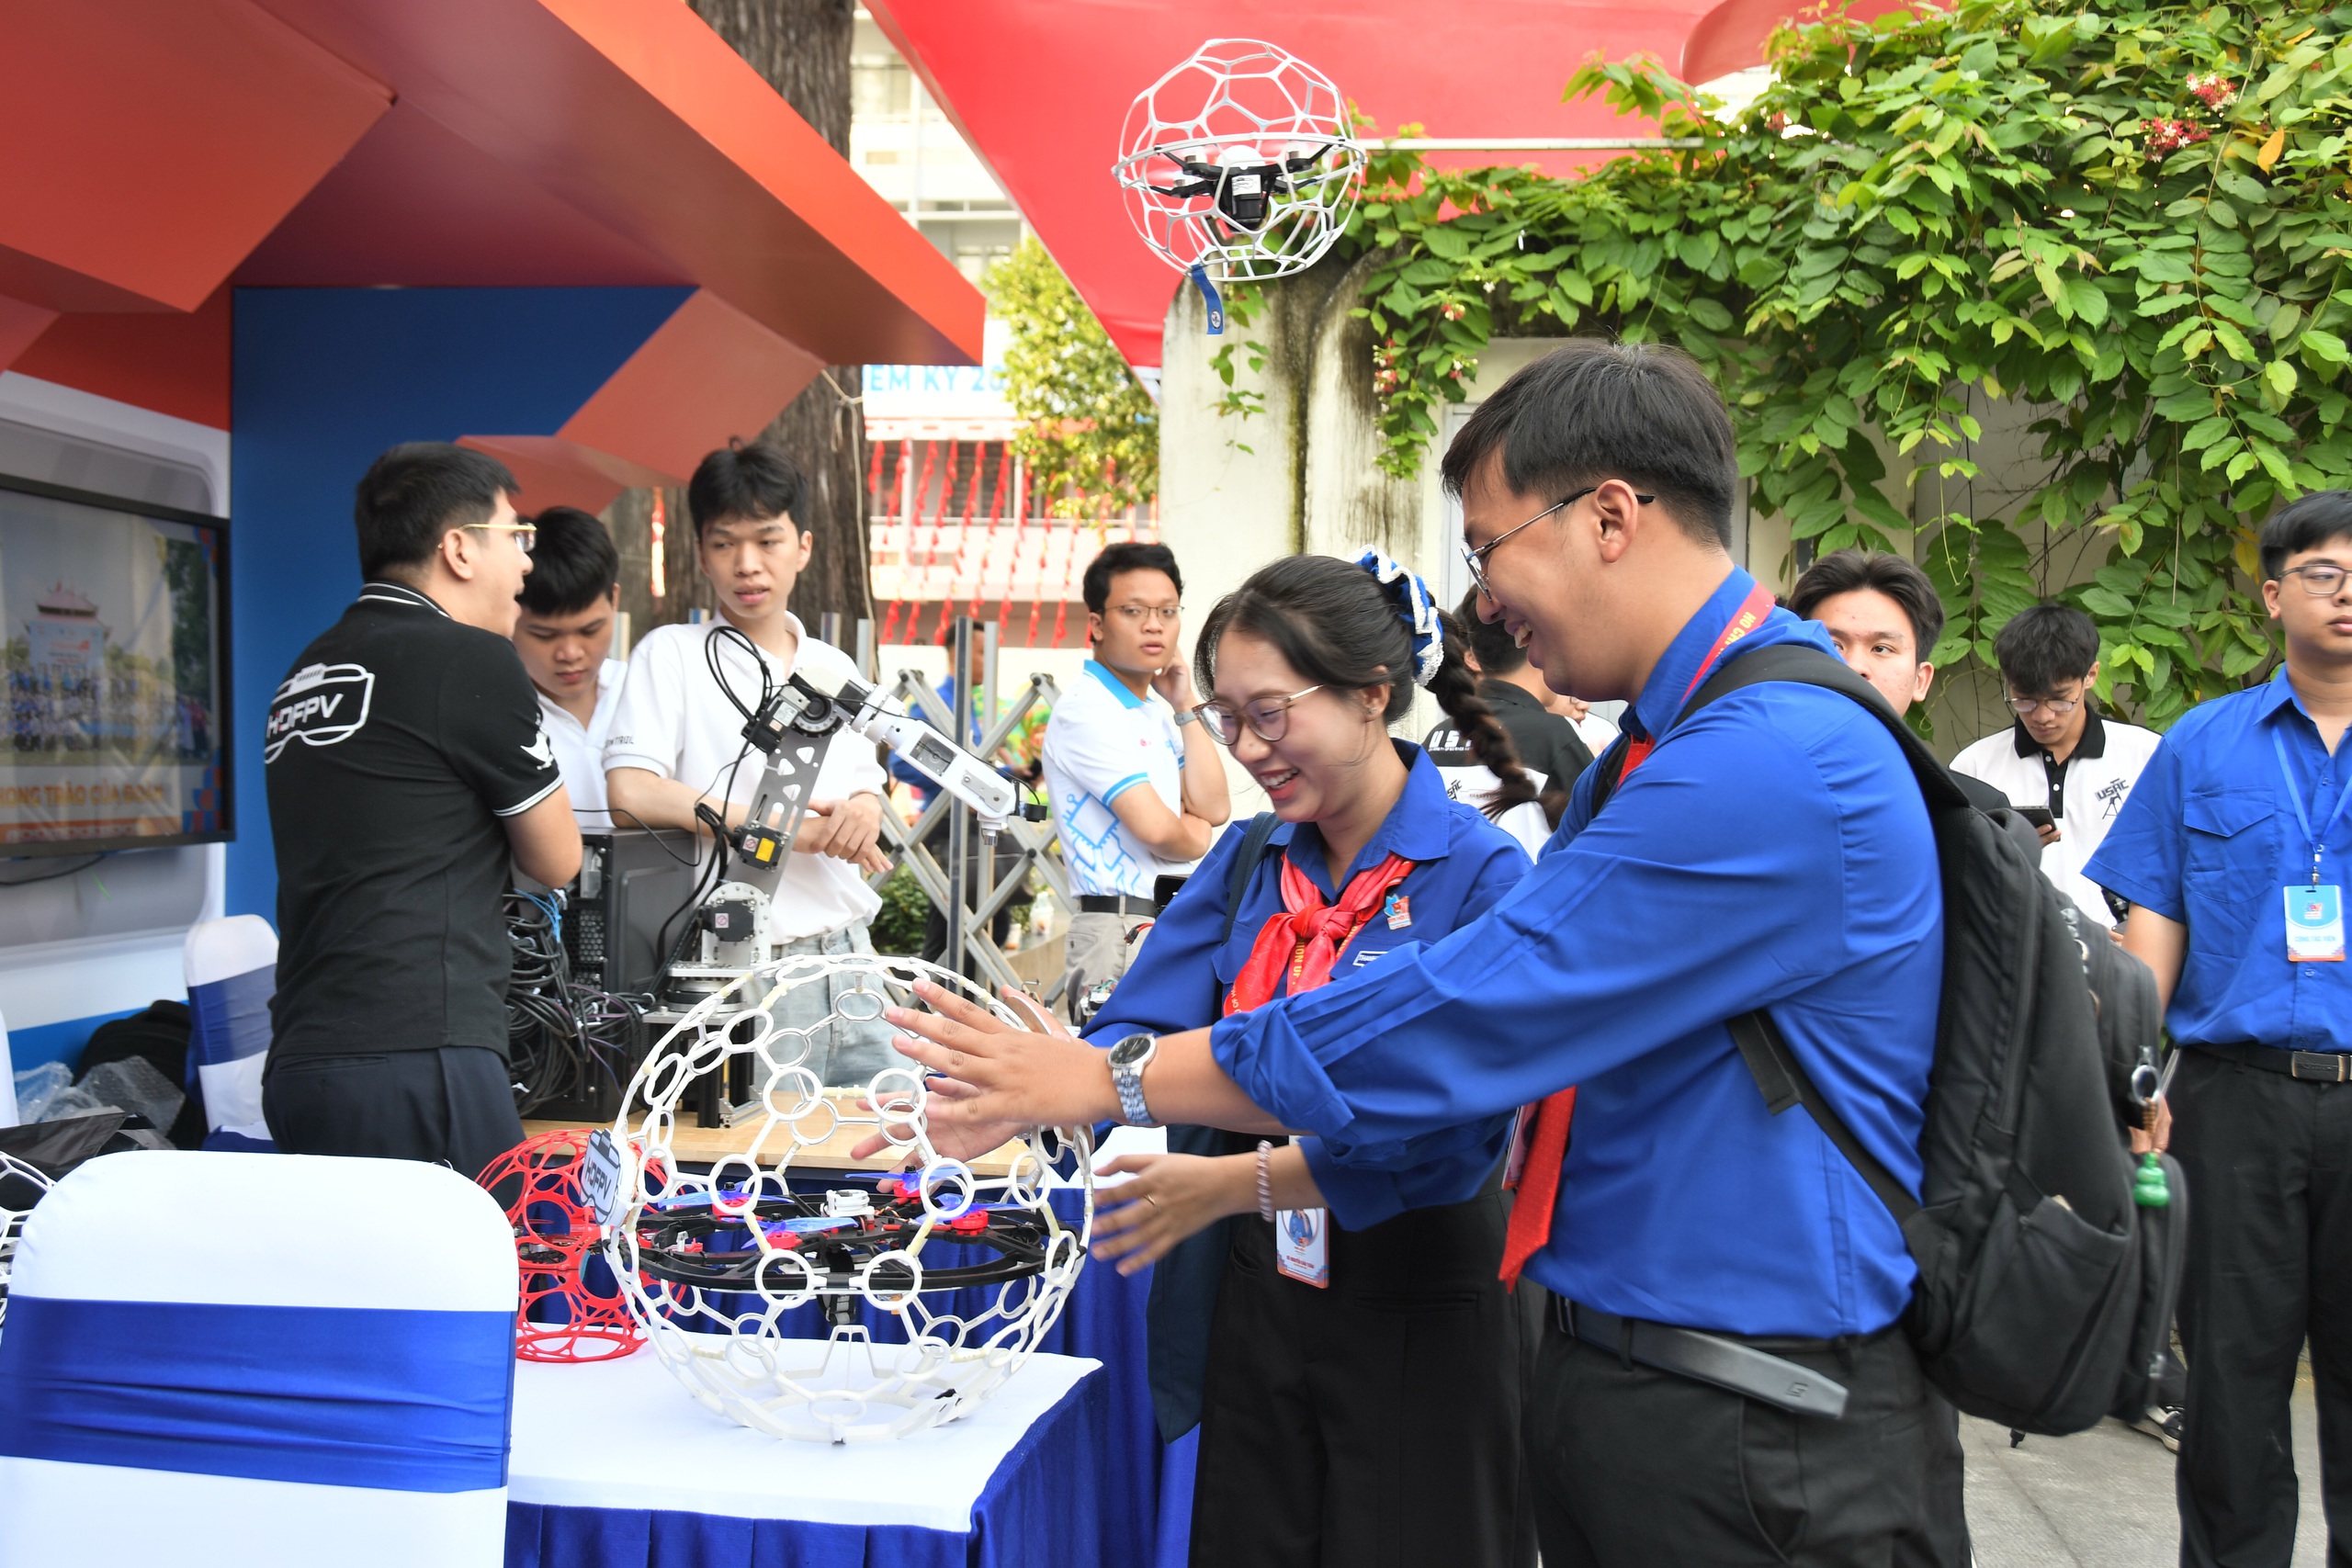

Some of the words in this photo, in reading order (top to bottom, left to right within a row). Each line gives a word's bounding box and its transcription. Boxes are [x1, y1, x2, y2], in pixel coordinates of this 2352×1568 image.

[1739, 611, 1757, 628] HO
[1429, 729, 1472, 749] US
[1447, 780, 1463, 798] SAC
